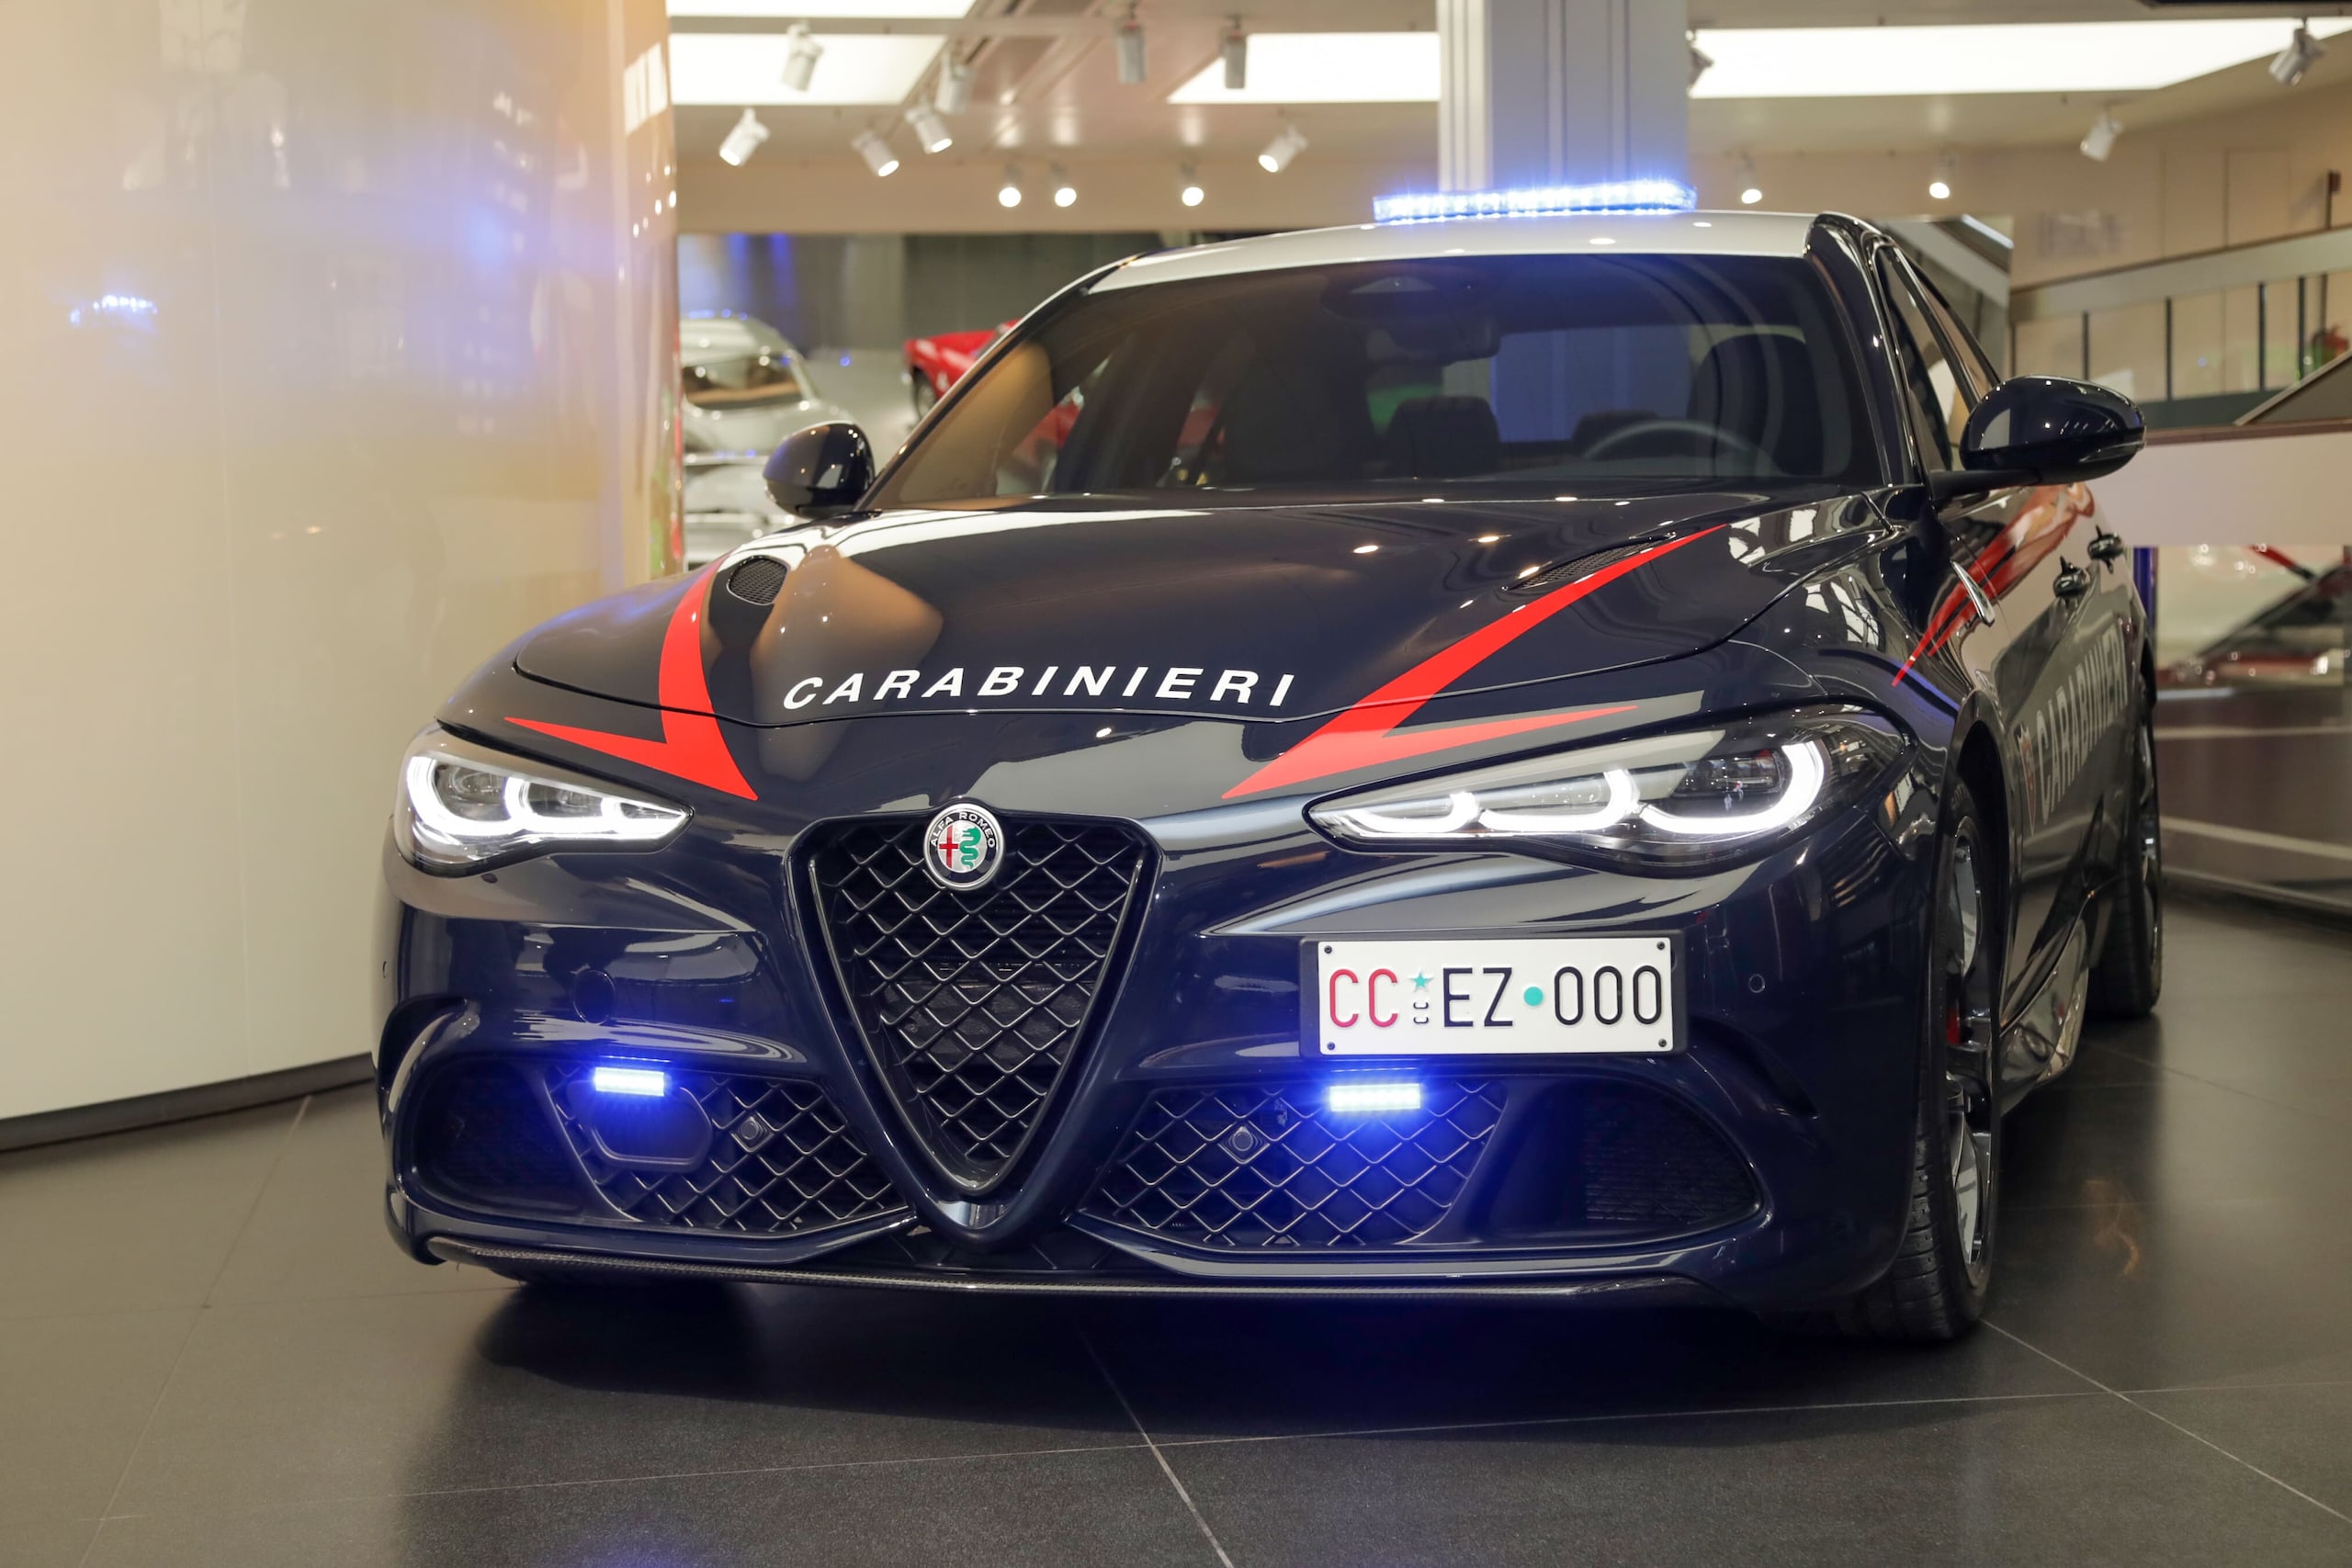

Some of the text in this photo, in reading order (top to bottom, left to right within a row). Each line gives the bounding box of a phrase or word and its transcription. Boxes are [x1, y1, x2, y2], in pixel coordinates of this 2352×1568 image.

[783, 665, 1295, 710] CARABINIERI
[2036, 622, 2128, 825] CARABINIERI
[931, 811, 996, 848] ALFA ROMEO
[1329, 965, 1662, 1028] CC EZ 000
